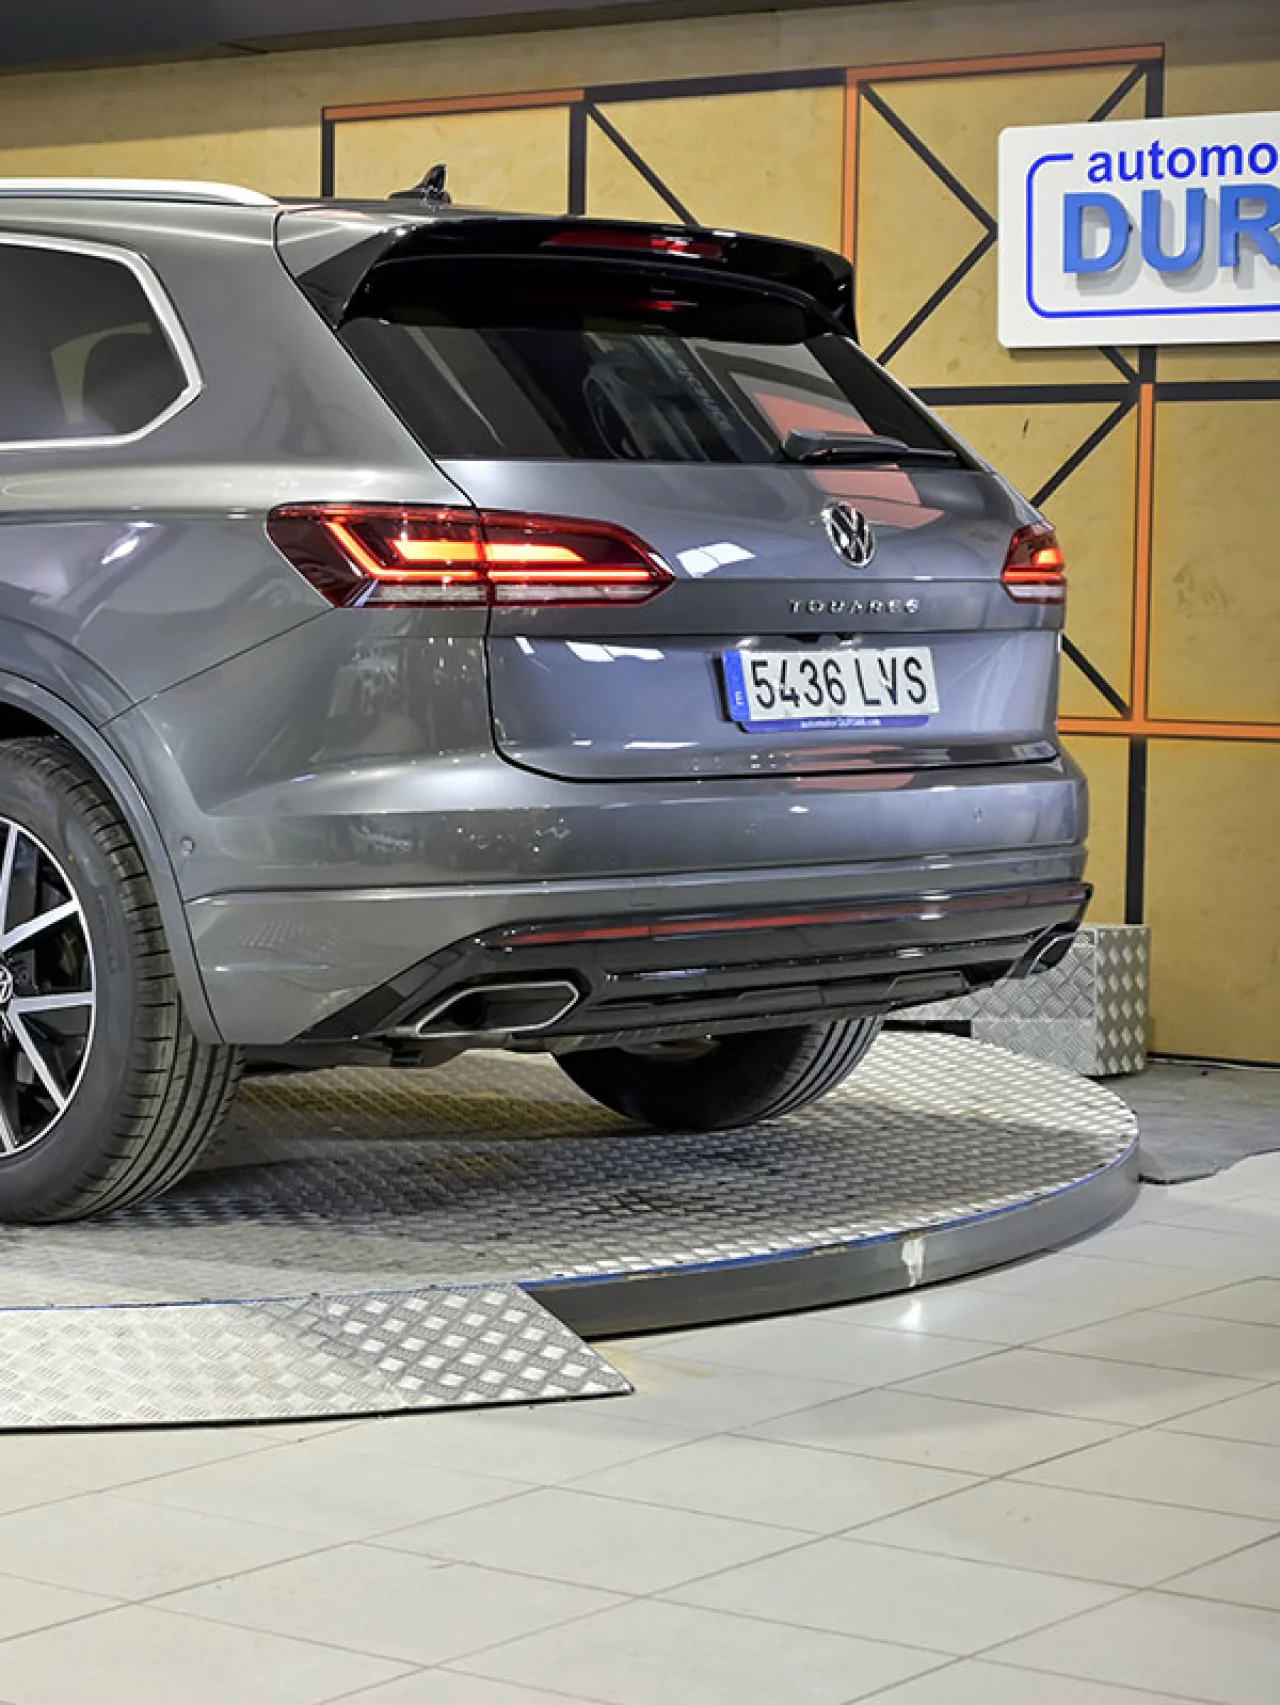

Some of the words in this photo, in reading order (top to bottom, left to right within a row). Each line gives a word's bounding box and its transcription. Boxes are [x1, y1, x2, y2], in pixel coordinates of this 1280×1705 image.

[1087, 139, 1279, 184] automo
[1063, 183, 1280, 275] DUR
[750, 658, 846, 710] 5436
[854, 655, 927, 706] LVS
